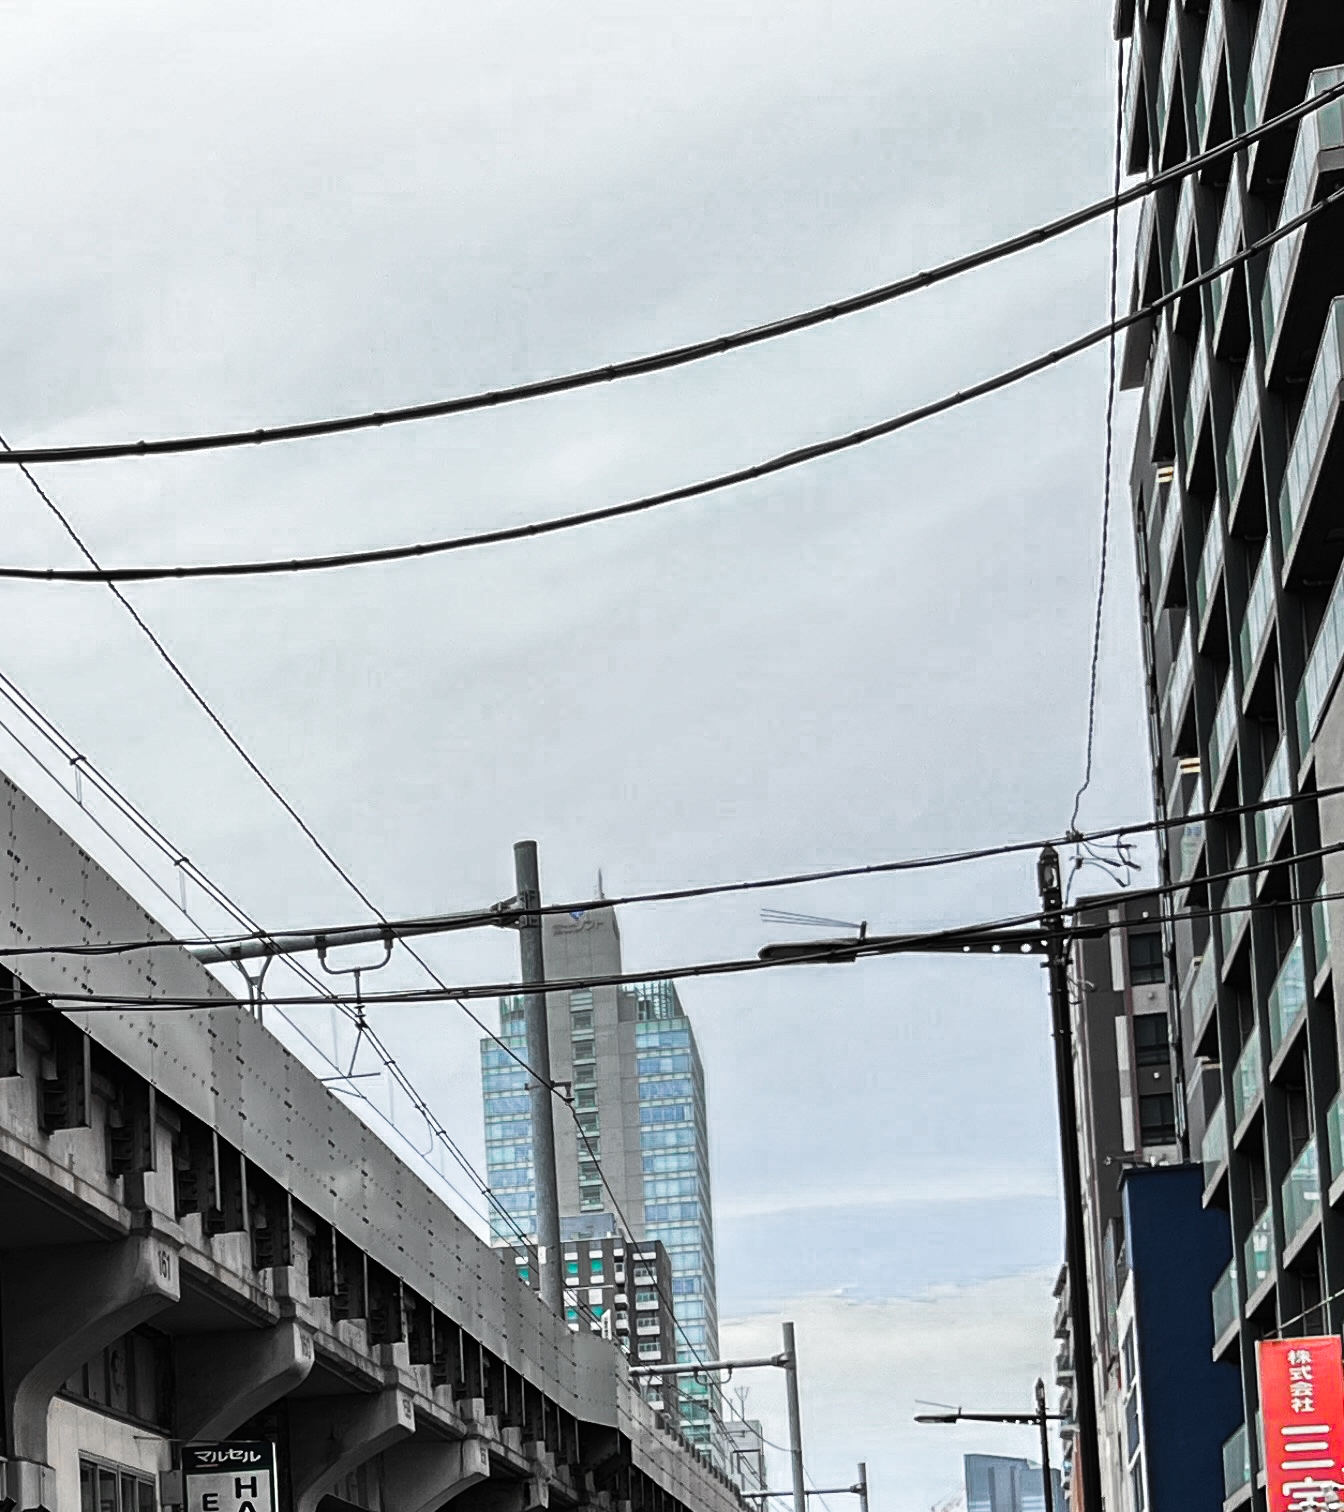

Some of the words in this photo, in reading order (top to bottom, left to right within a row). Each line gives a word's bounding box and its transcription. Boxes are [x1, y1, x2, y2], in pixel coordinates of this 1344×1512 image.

[1287, 1349, 1315, 1413] 株式会社
[193, 1448, 262, 1464] マルセル
